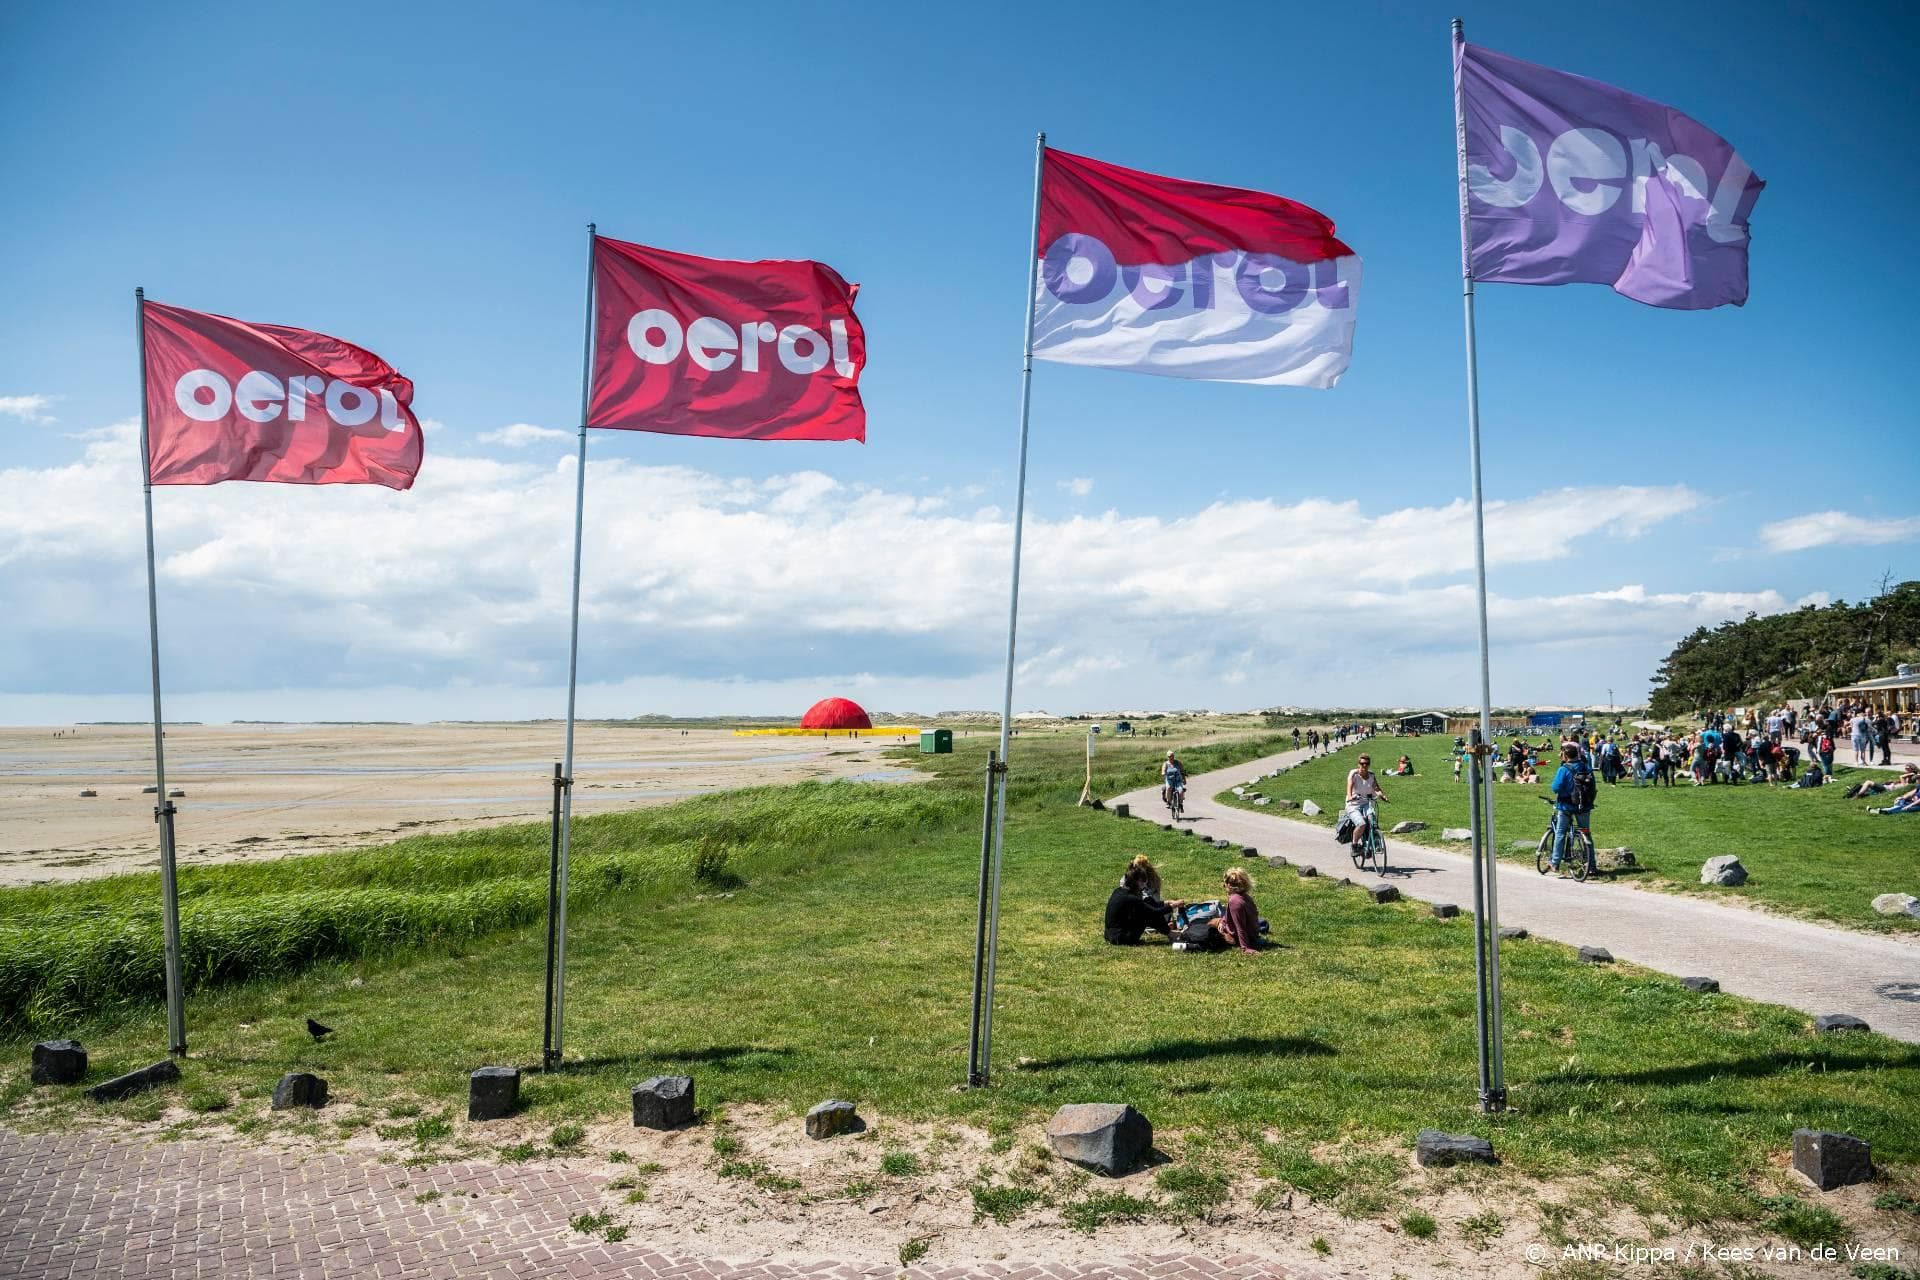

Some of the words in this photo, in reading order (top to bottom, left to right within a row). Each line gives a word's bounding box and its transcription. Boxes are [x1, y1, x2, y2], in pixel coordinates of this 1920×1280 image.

[1043, 232, 1350, 314] oerol
[627, 308, 855, 379] oerol
[174, 369, 405, 433] oerol
